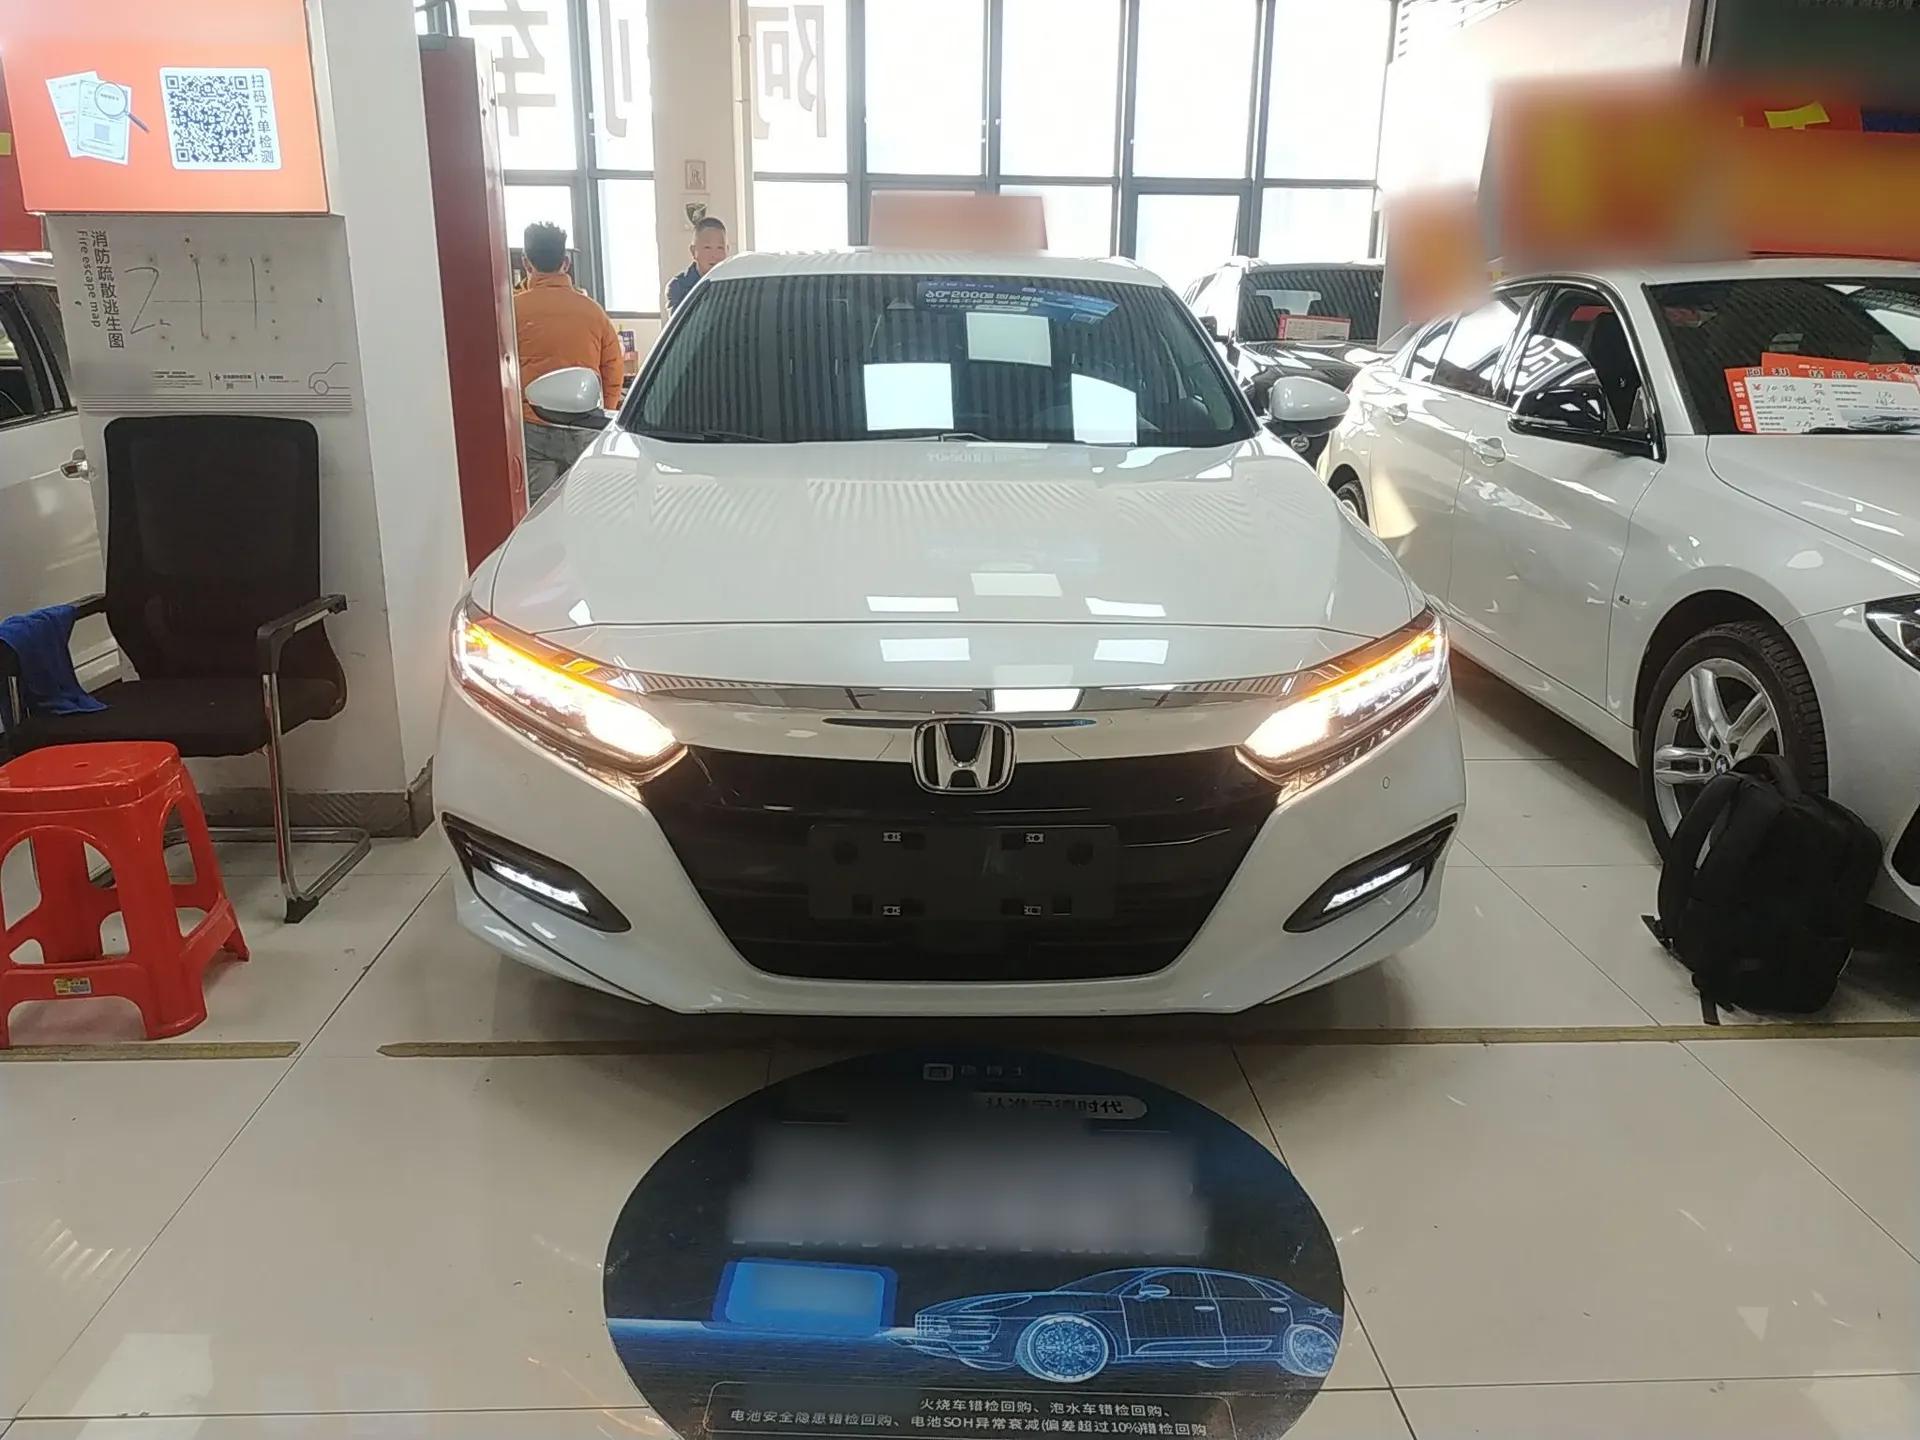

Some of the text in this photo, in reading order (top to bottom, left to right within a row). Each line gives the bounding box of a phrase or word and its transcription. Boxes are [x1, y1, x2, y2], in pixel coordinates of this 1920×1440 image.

[251, 74, 275, 163] 扫码下单检测
[77, 229, 101, 328] Fire escape map
[91, 229, 125, 349] 消防疏散逃生图
